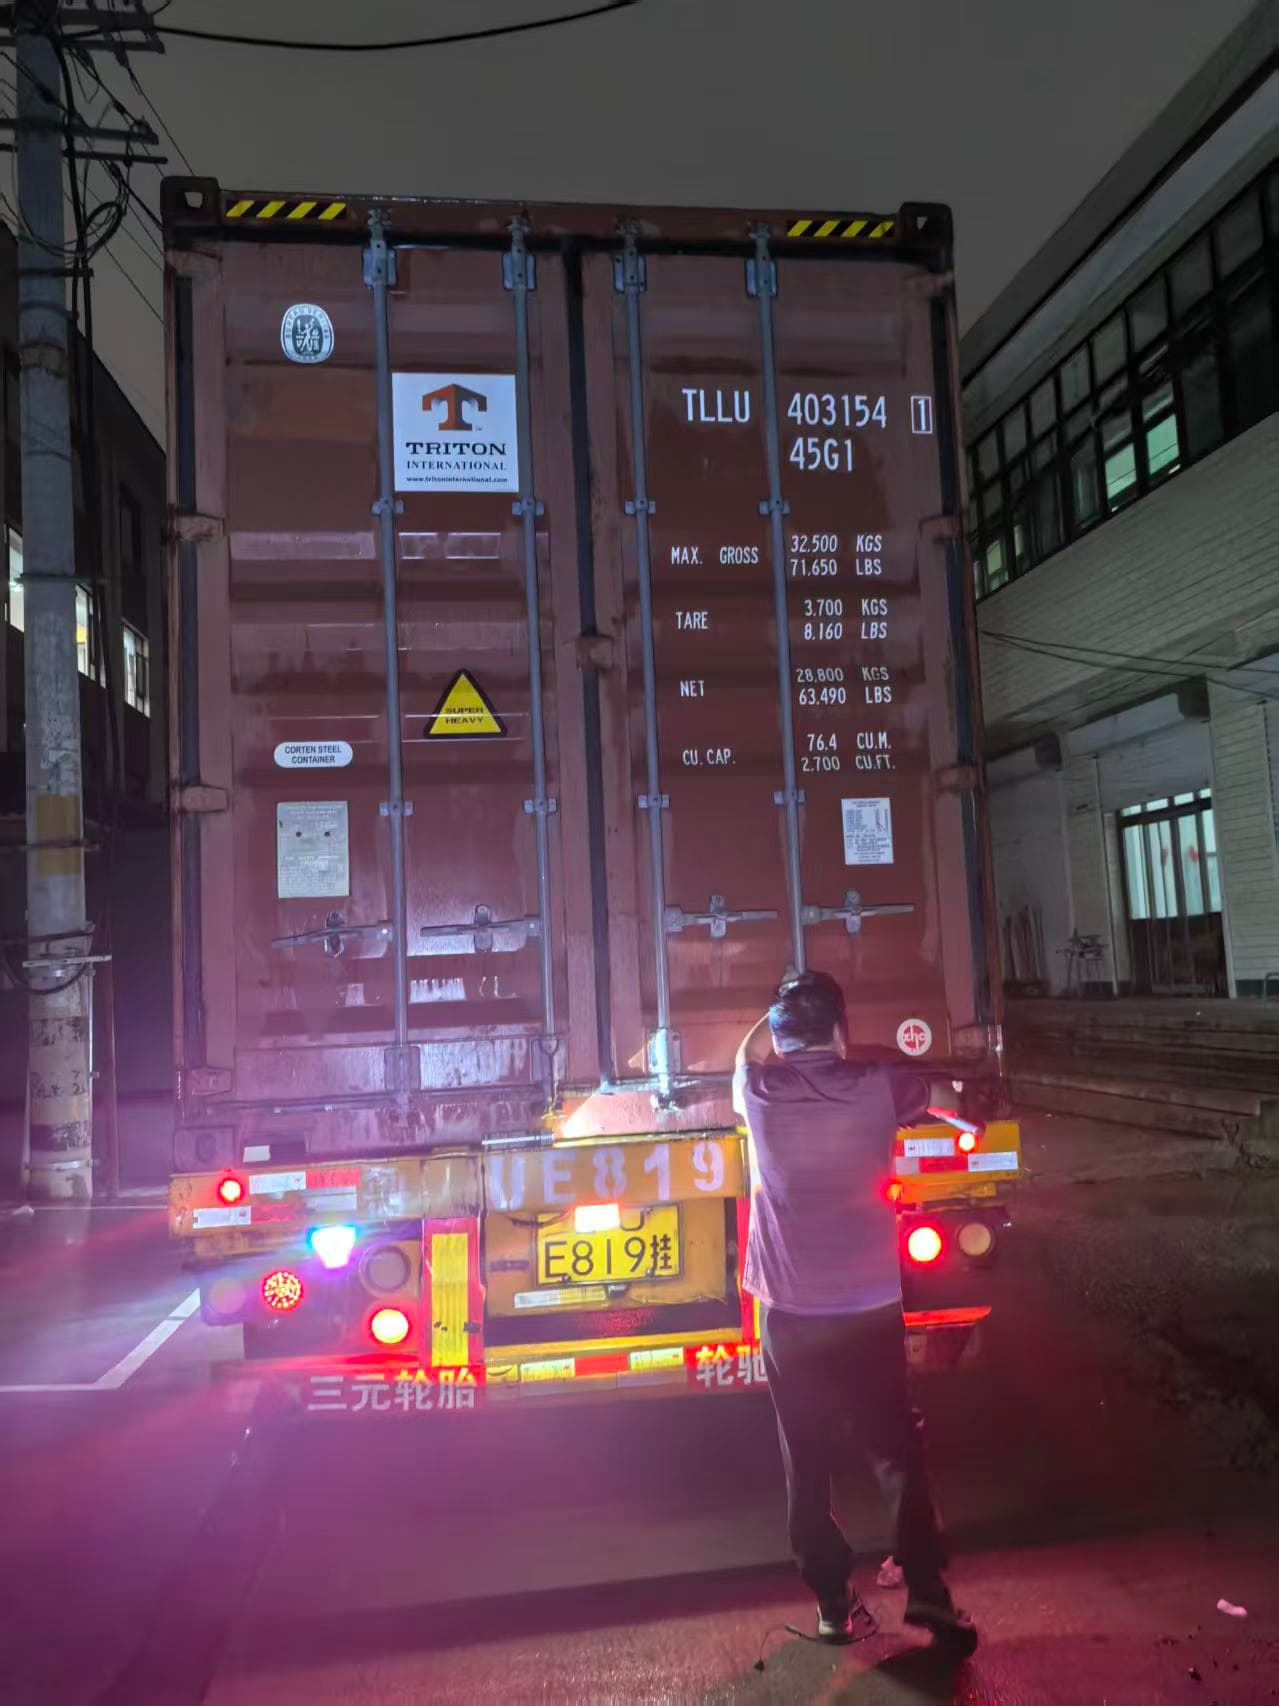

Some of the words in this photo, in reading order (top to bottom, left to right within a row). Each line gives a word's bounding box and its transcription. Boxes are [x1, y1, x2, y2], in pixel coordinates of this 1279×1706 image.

[682, 388, 750, 423] TLLU
[787, 392, 887, 429] 403154
[405, 442, 507, 456] TRITON
[789, 436, 853, 472] 45G1
[406, 460, 508, 471] INTERNATIONAL
[671, 546, 703, 565] MAX.
[719, 546, 759, 565] GROSS
[855, 534, 883, 553] KGS
[855, 558, 883, 576] LBS
[675, 611, 709, 630] TARE
[861, 598, 888, 616] KGS
[860, 621, 888, 640] LBS
[680, 680, 705, 697] NET
[861, 666, 889, 682] KGS
[865, 685, 892, 704] LBS
[445, 707, 484, 716] SUPER
[445, 716, 484, 724] HEAVY
[284, 745, 316, 754] CORTEN
[318, 745, 342, 753] STEEL
[807, 733, 838, 752] 76.4
[291, 755, 336, 764] CONTAINER
[489, 1141, 725, 1212] UE819
[544, 1233, 672, 1279] E819挂
[307, 1368, 476, 1412] 三元轮胎
